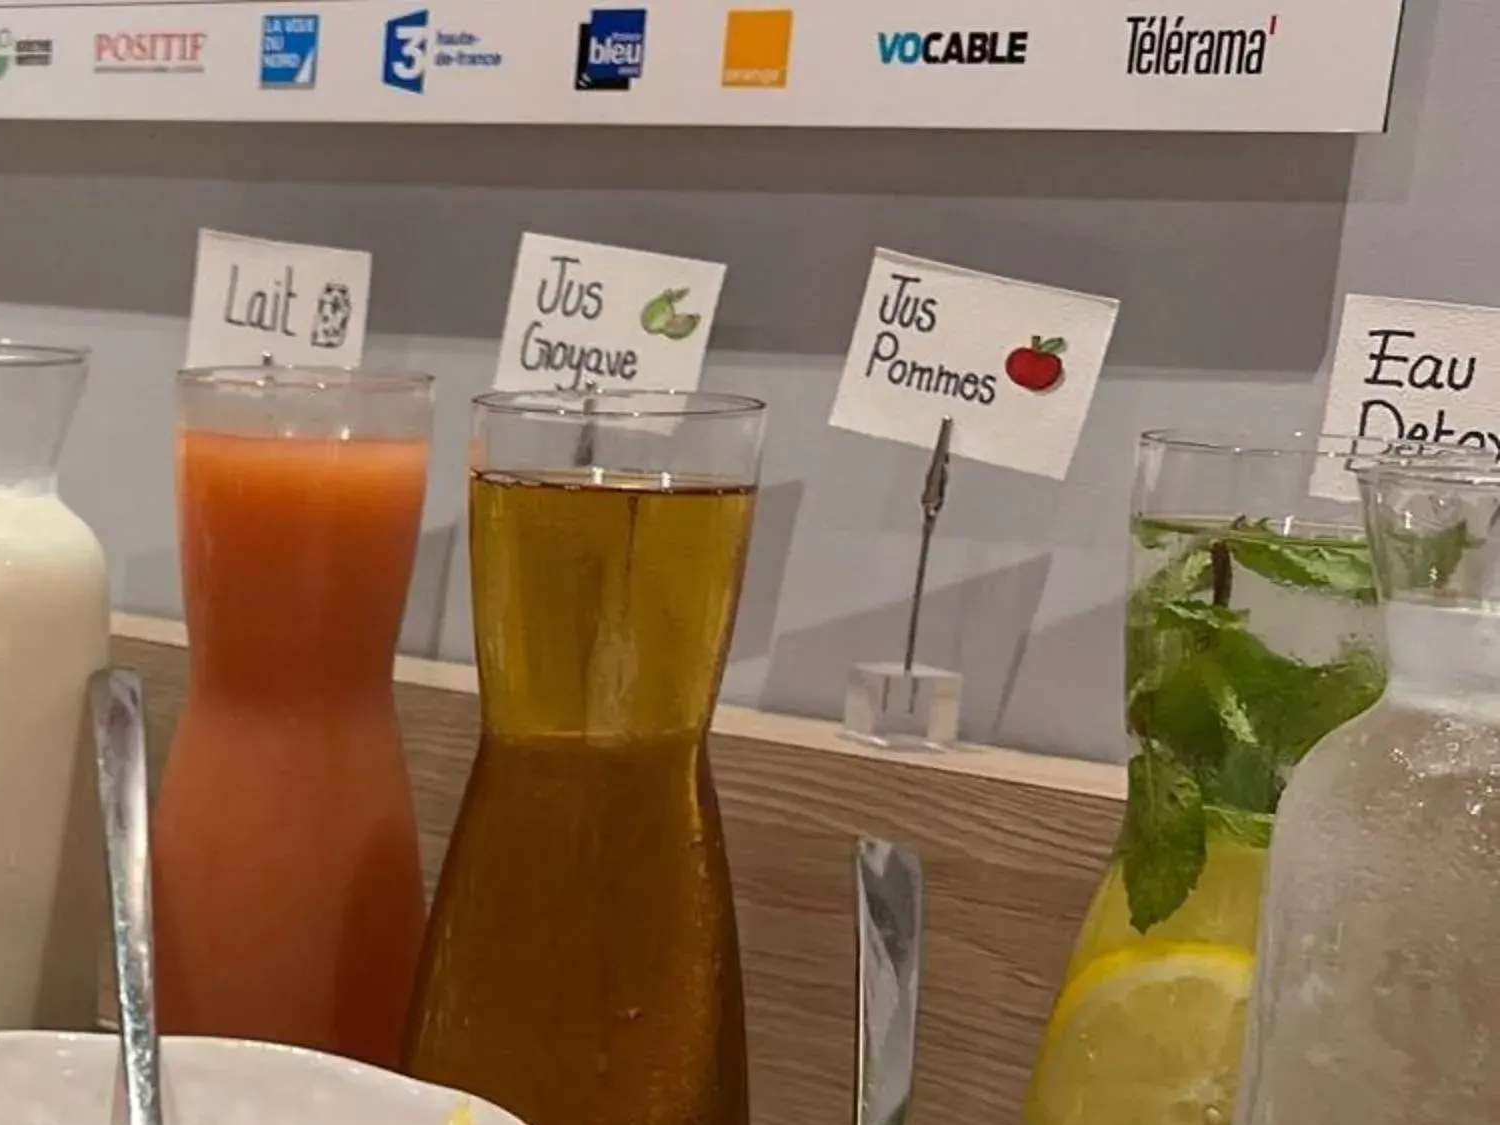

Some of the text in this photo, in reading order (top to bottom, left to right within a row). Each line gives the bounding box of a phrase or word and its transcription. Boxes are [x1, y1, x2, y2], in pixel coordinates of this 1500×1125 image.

[95, 33, 206, 62] POSITIF
[264, 19, 282, 32] LA
[392, 26, 423, 79] 3
[589, 36, 641, 65] bleu
[878, 32, 1028, 65] VOCABLE
[225, 264, 298, 337] Lait
[537, 256, 603, 320] Jus
[879, 273, 938, 333] Jus
[520, 320, 638, 392] Goyave
[866, 331, 997, 405] Pommes
[1364, 329, 1477, 391] Eau
